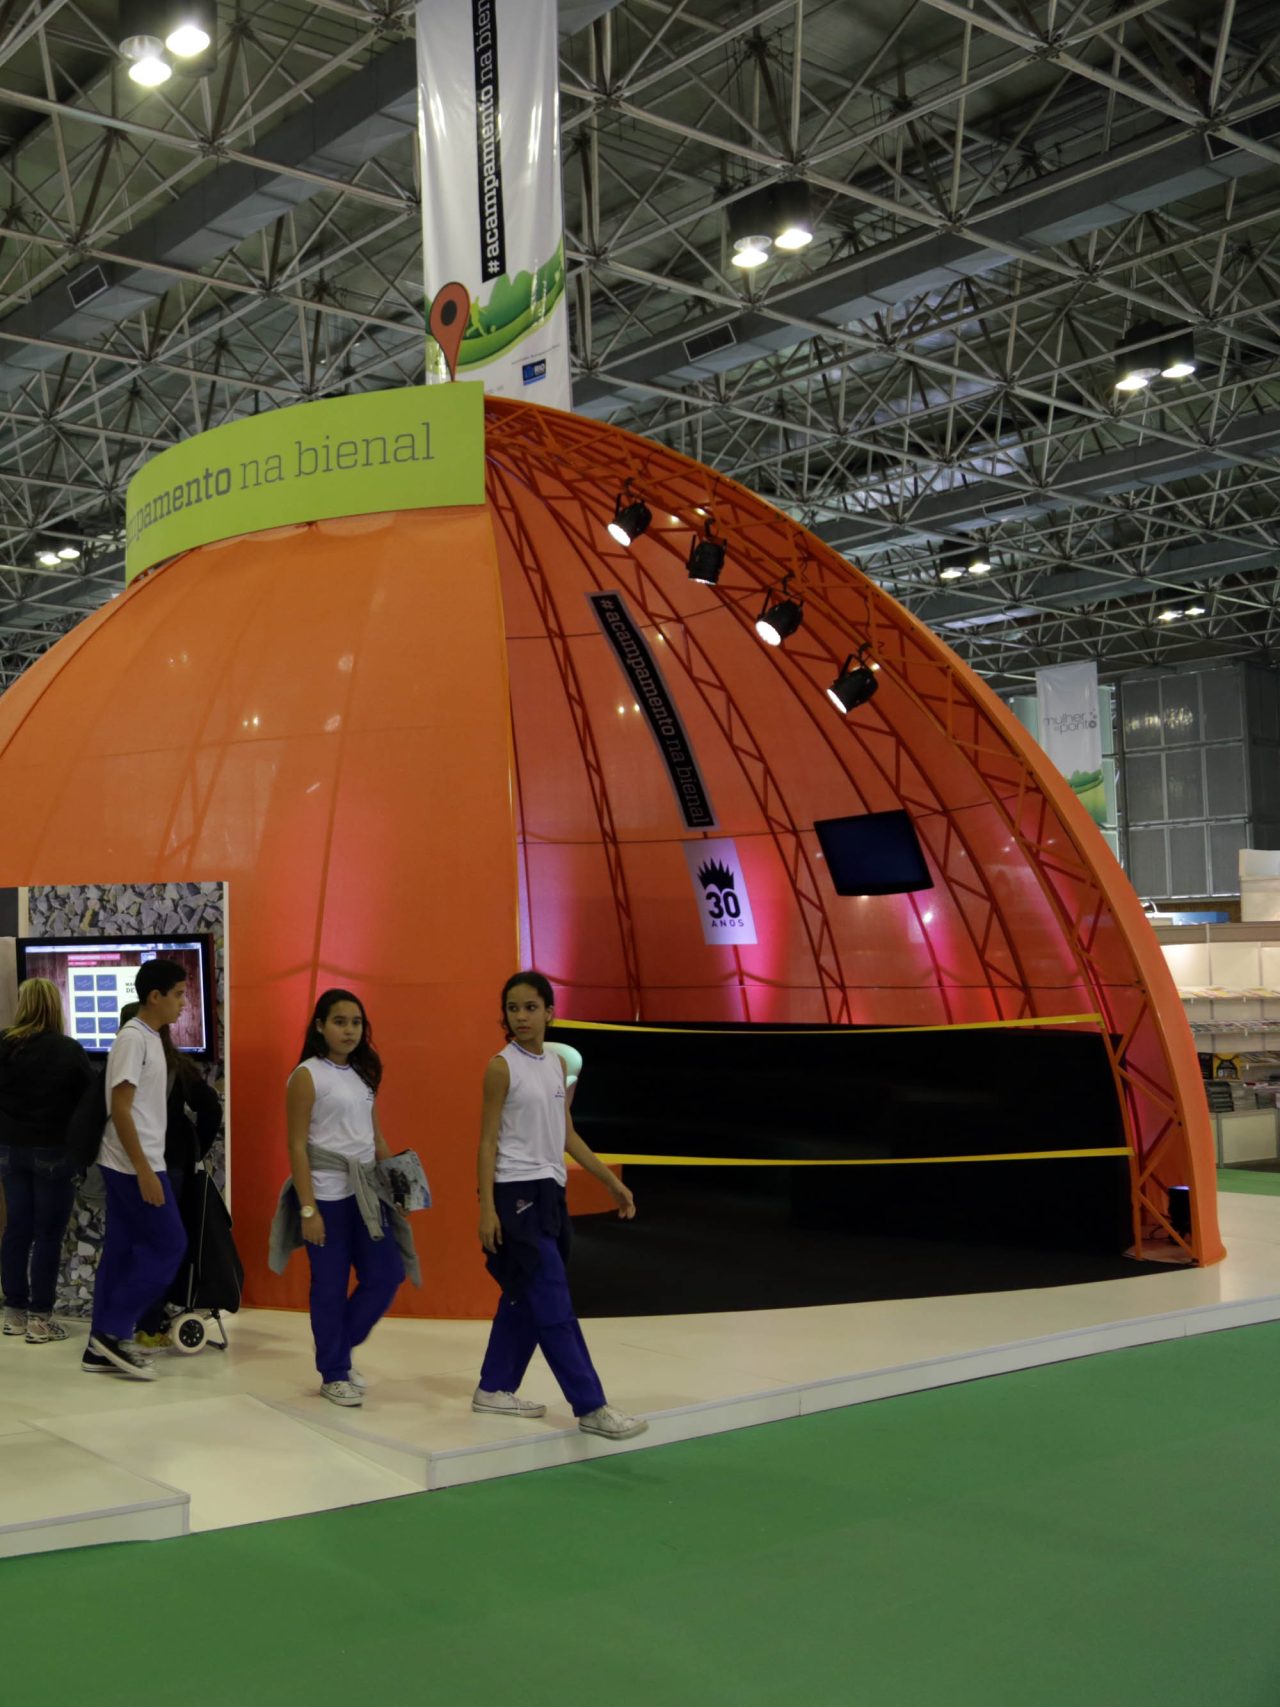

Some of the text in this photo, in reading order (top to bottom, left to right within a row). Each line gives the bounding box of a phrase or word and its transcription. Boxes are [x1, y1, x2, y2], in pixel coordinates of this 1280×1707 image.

[480, 50, 493, 84] na
[240, 455, 284, 490] na
[295, 422, 435, 478] bienal
[600, 599, 710, 825] #acampamento na bienal
[706, 891, 741, 919] 30
[711, 919, 744, 928] ANOS
